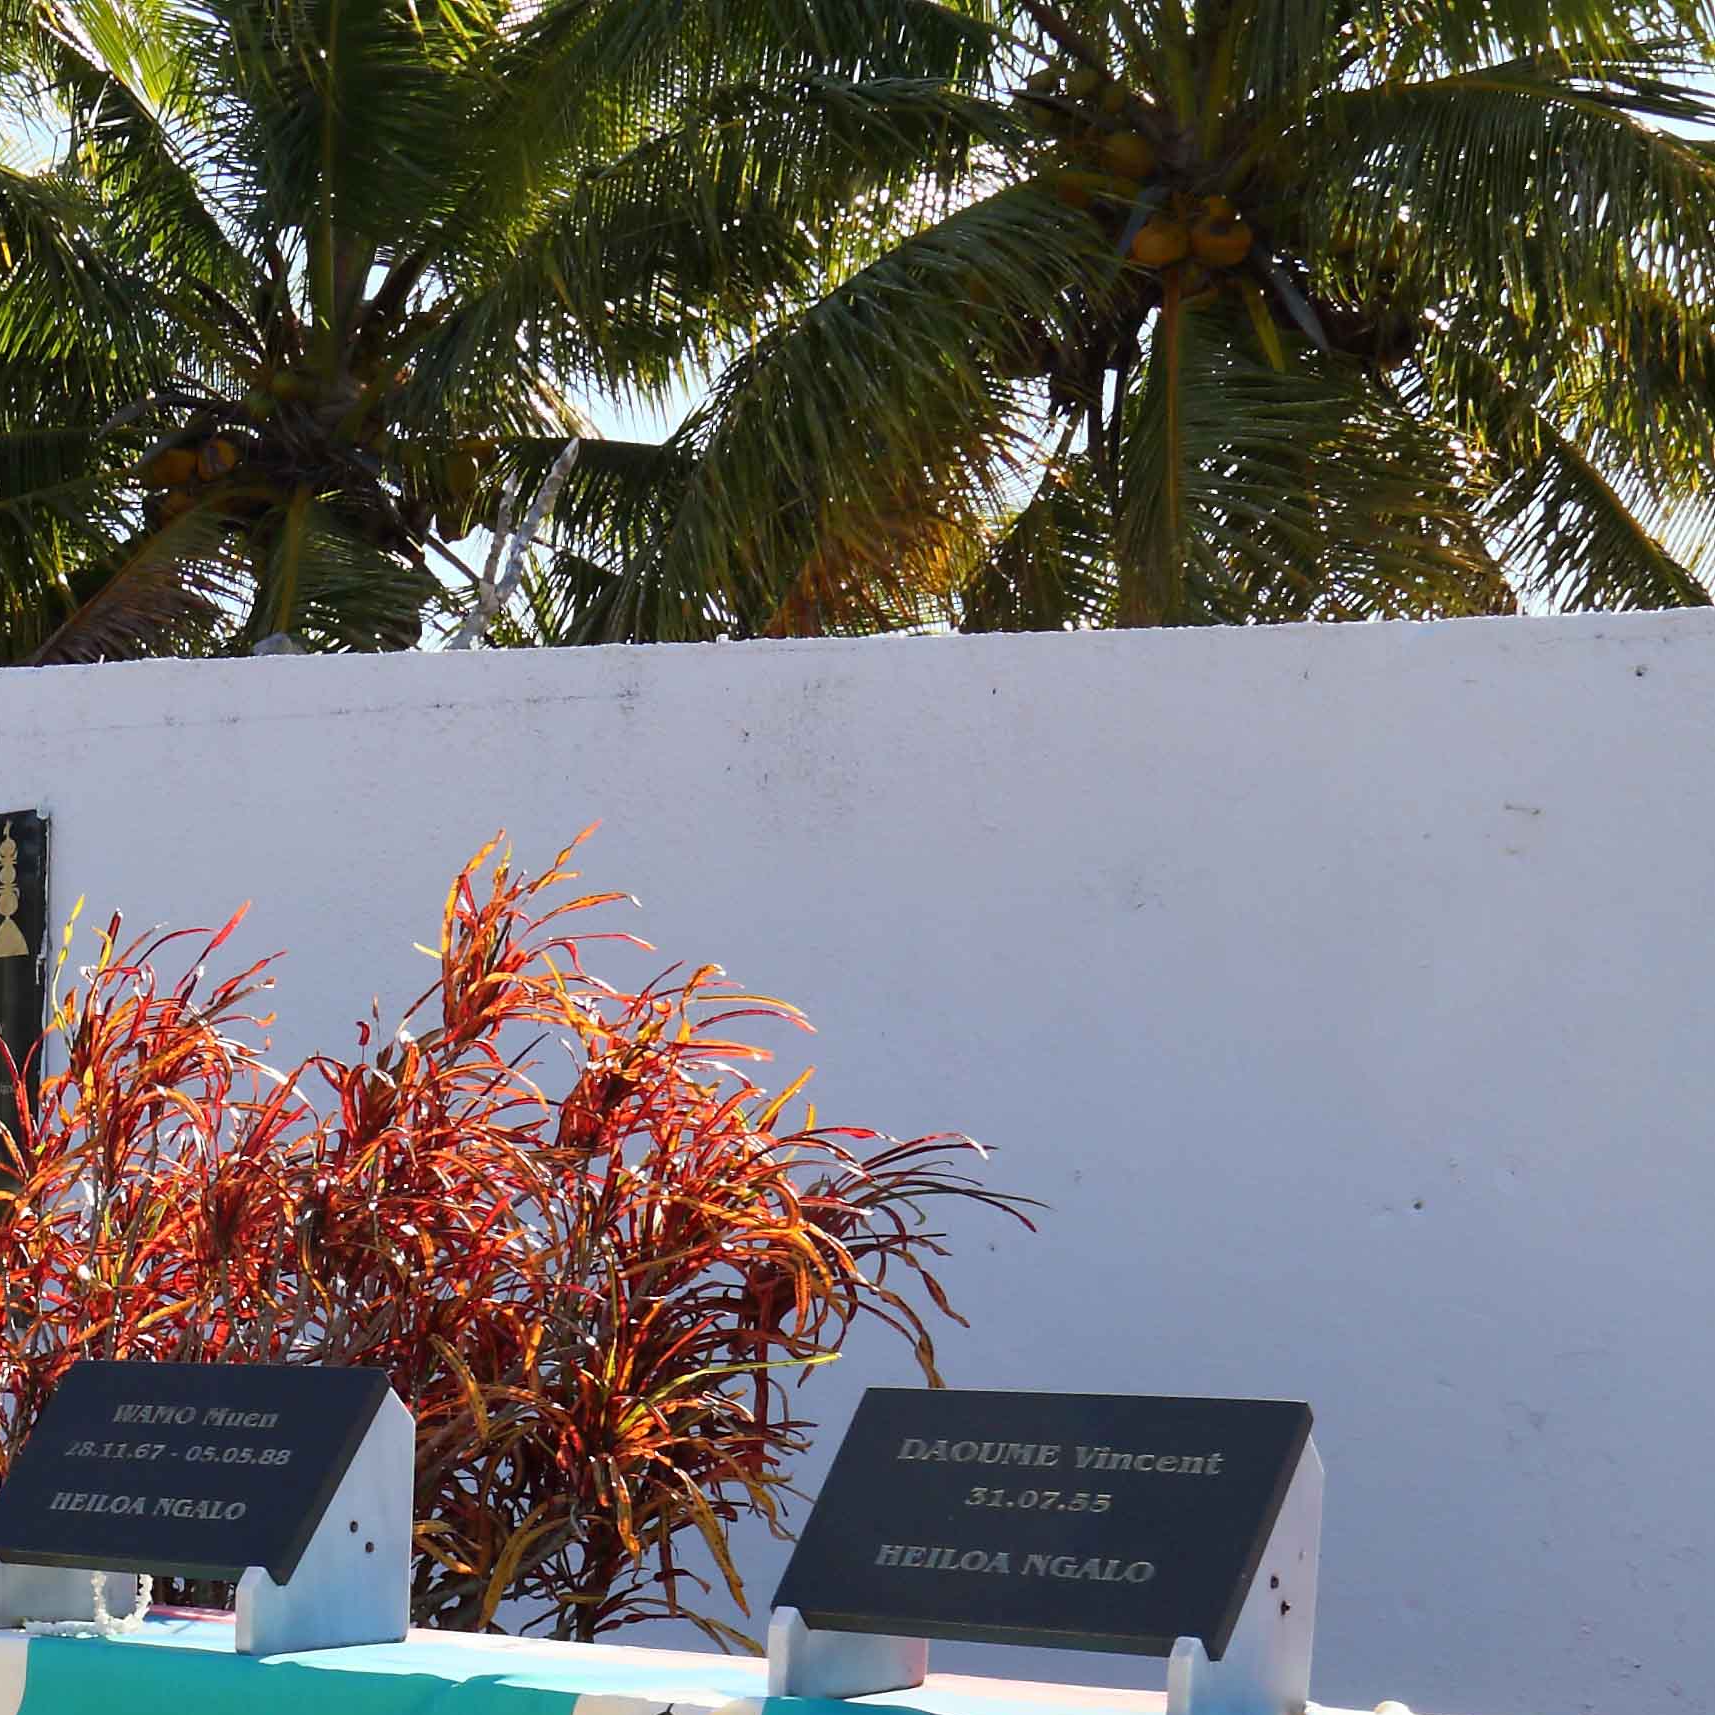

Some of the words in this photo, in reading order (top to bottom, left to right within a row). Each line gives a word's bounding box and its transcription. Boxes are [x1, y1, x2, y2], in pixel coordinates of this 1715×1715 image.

[112, 1403, 197, 1426] WAMO
[202, 1406, 281, 1429] Muen
[64, 1440, 167, 1462] 28.11.67
[184, 1444, 292, 1467] 05.05.88
[896, 1437, 1062, 1468] DAOUME
[1074, 1444, 1226, 1477] Vincent
[49, 1490, 147, 1516] HEILOA
[151, 1496, 248, 1522] NGALO
[964, 1486, 1114, 1514] 31.07.55
[873, 1542, 1012, 1576] HEILOA
[1019, 1552, 1157, 1585] NGALO
